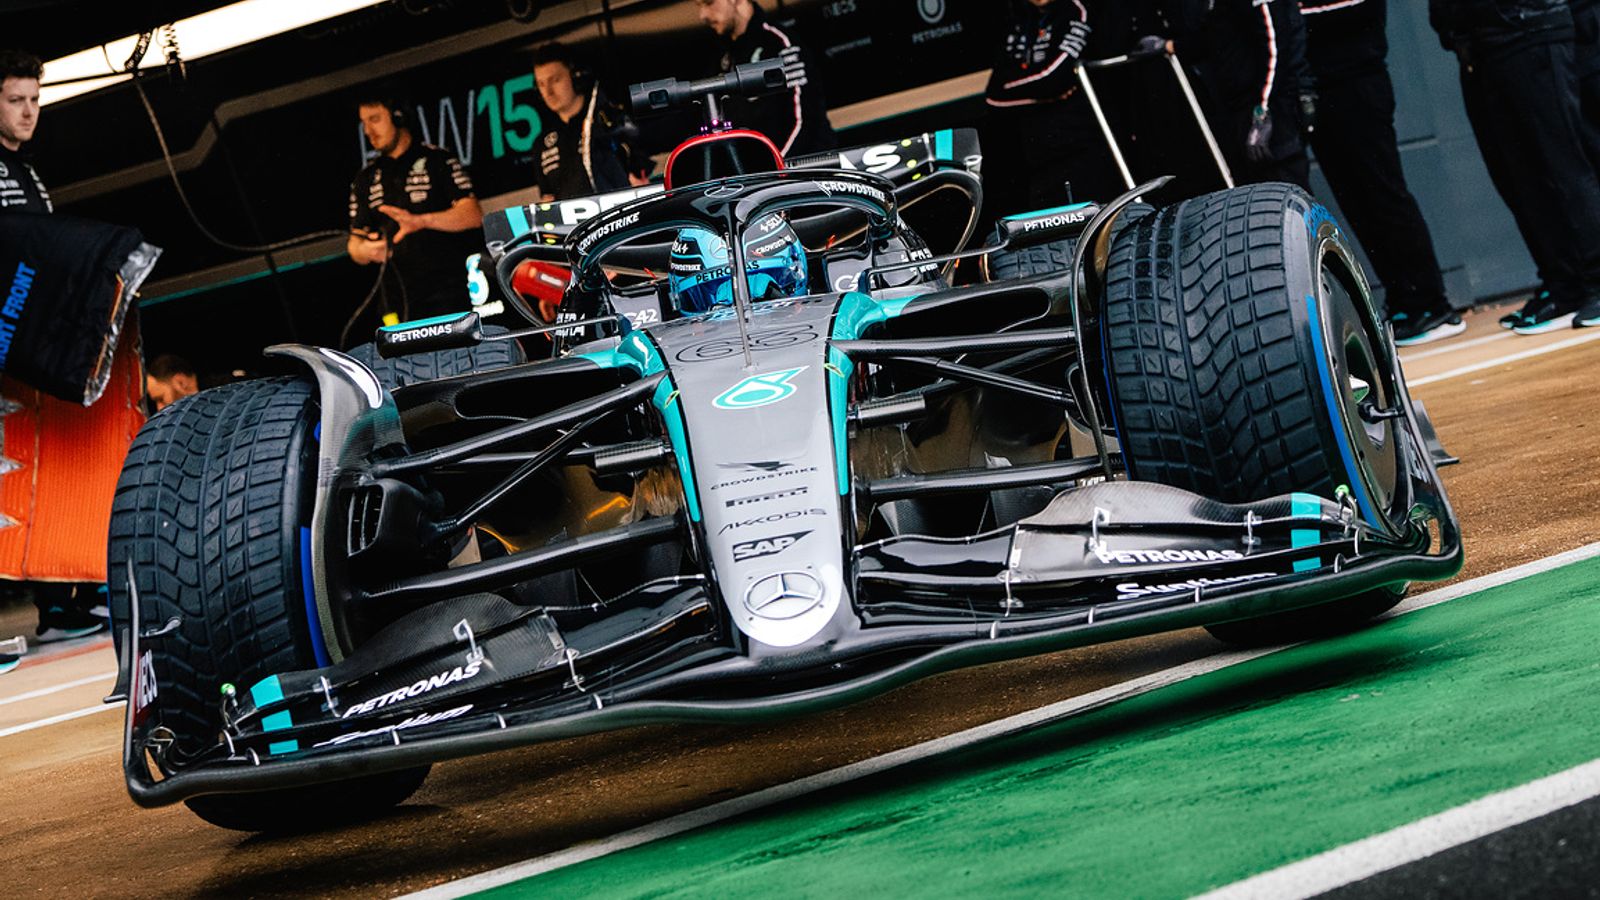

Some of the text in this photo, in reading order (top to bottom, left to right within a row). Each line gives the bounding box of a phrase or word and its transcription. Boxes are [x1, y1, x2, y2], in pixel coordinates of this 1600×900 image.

[1023, 212, 1085, 232] PETRONAS
[696, 260, 760, 284] PETROAS
[2, 261, 37, 319] FRONT
[391, 323, 453, 343] PETRONAS
[711, 467, 818, 490] CROWDSTRIKE
[725, 486, 808, 508] PIRELLI
[733, 537, 798, 562] SAP
[1095, 550, 1244, 564] PETRONAS
[342, 661, 482, 718] PETRONAS
